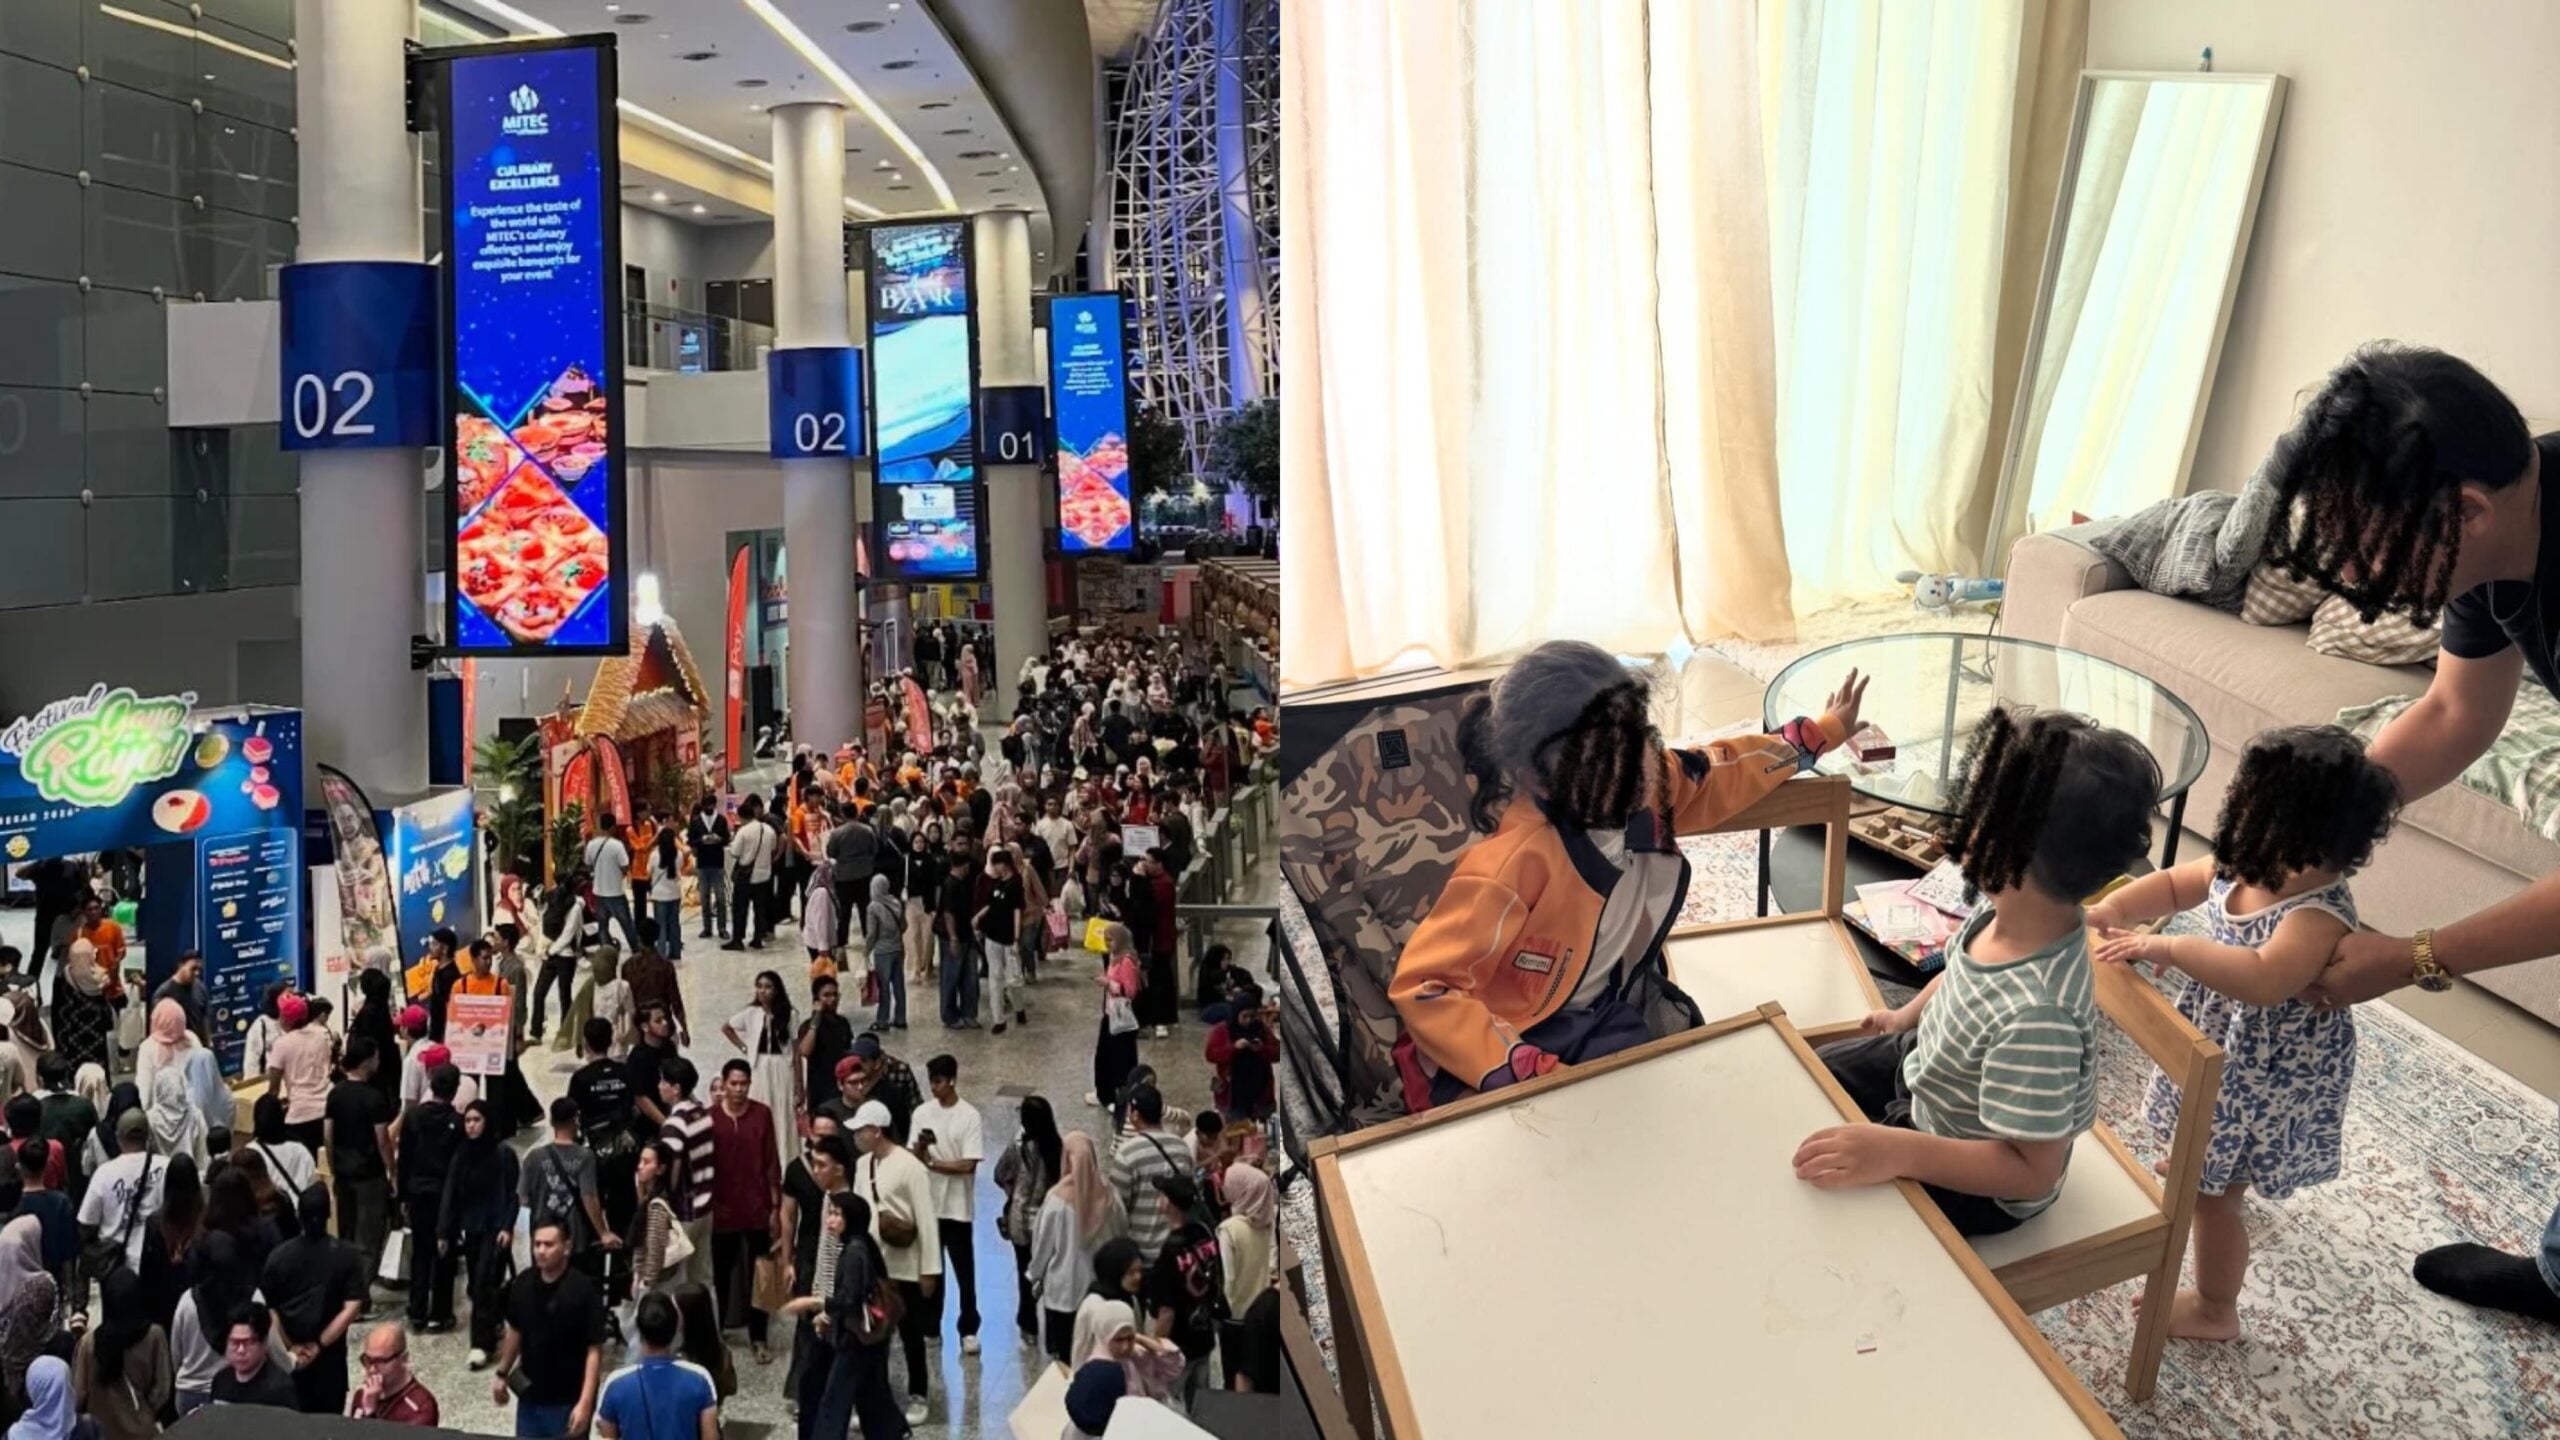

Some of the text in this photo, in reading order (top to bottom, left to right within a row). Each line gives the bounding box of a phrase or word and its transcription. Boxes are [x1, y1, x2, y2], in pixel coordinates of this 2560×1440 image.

[502, 113, 548, 129] MITEC
[497, 162, 553, 176] CULINARY
[489, 175, 561, 191] EXCELLENCE
[470, 198, 582, 219] Experience the taste of
[490, 214, 562, 229] the world with
[486, 228, 567, 242] MITEC's culinary
[479, 241, 574, 257] offerings and enjoy
[471, 252, 582, 272] exquisite banquets for
[500, 272, 523, 284] your
[293, 370, 376, 438] 02
[794, 412, 847, 452] 02
[1000, 431, 1034, 460] 01
[3, 685, 104, 751] Festival
